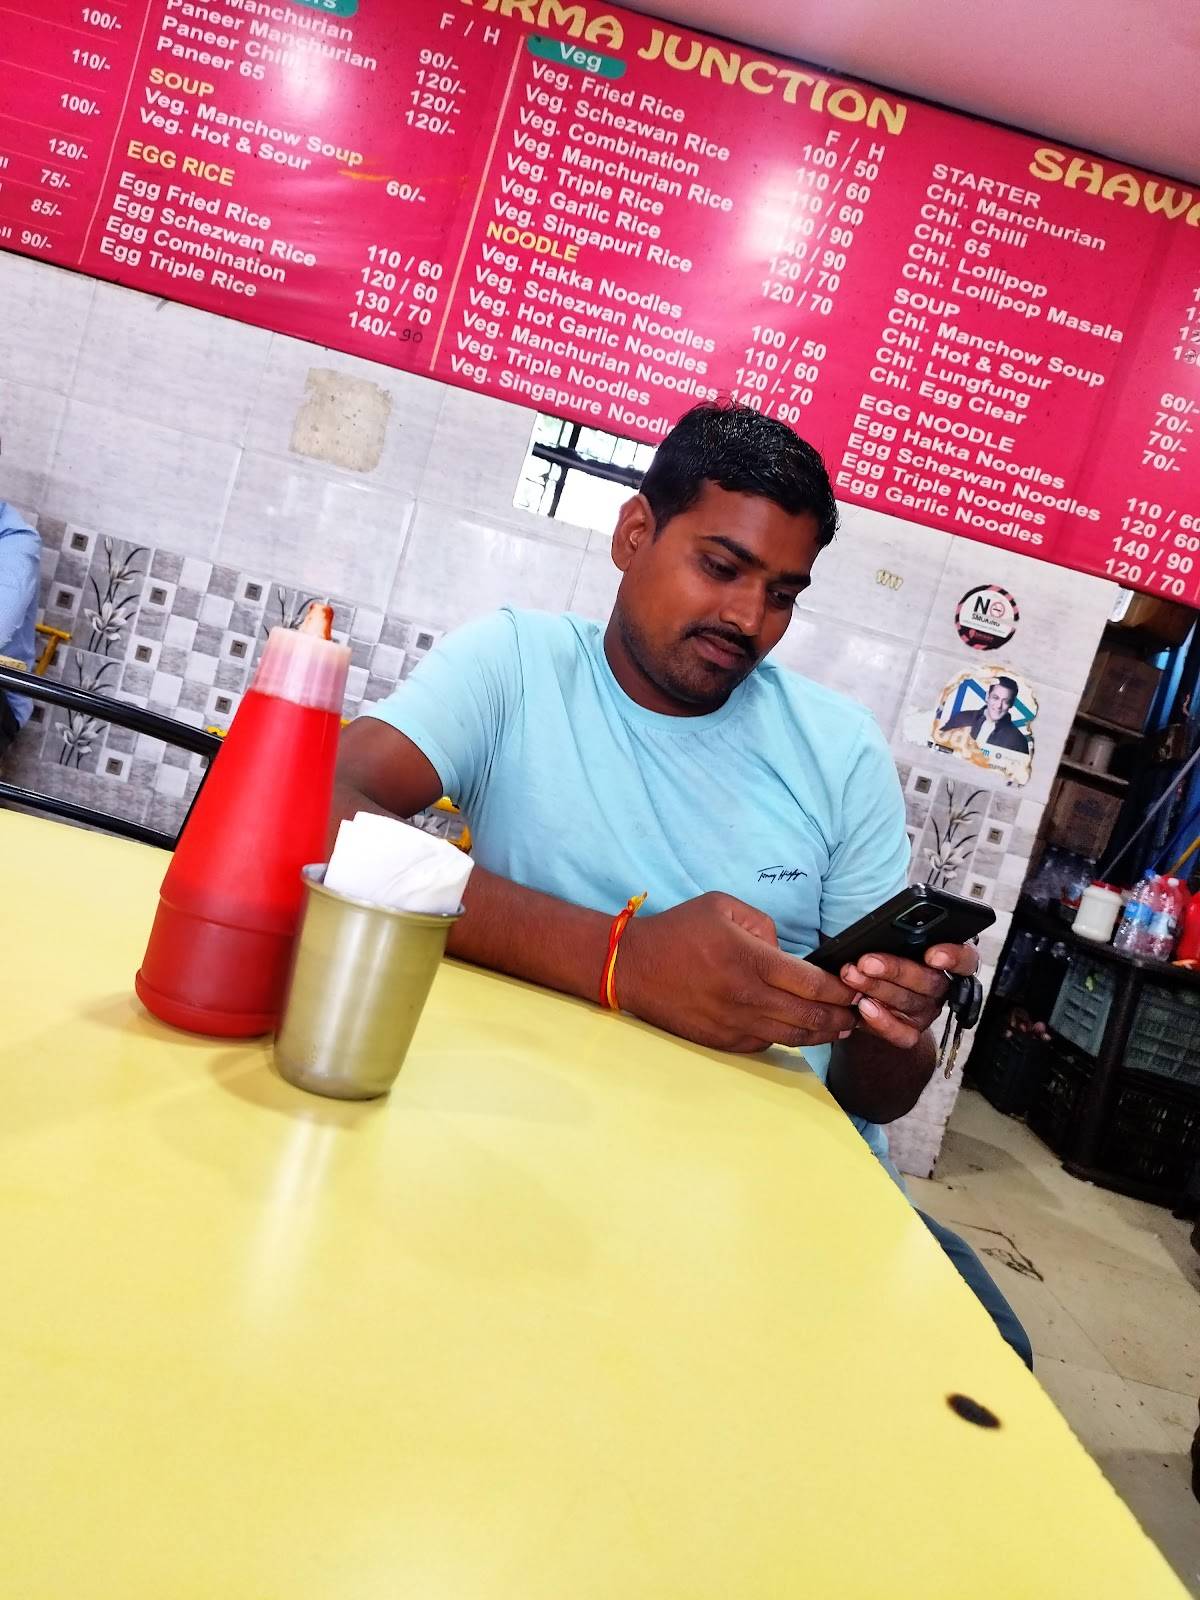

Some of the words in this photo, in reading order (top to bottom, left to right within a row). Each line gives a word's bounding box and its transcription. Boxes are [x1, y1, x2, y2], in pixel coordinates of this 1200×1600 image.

[82, 8, 122, 30] 100/-
[162, 15, 240, 51] Paneer
[72, 49, 110, 71] 110/-
[157, 35, 235, 71] Paneer
[240, 61, 271, 81] 65
[419, 49, 459, 70] 90/-
[560, 42, 602, 73] Veg
[149, 68, 214, 97] SOUP
[416, 69, 466, 94] 120/-
[532, 60, 573, 91] Veg.
[581, 76, 635, 108] Fried
[639, 94, 685, 123] Rice
[637, 29, 907, 135] JUNCTION
[61, 93, 100, 115] 100/-
[410, 90, 460, 114] 120/-
[140, 107, 183, 135] Veg.
[191, 123, 231, 148] Hot
[258, 143, 311, 170] Sour
[145, 87, 189, 116] Veg.
[197, 103, 304, 147] Manchow
[305, 132, 363, 167] Soup
[405, 110, 455, 135] 120/-
[520, 106, 560, 137] Veg.
[568, 123, 700, 177] Combination
[526, 83, 567, 114] Veg.
[574, 100, 678, 146] Schezwan
[684, 133, 730, 162] Rice
[49, 138, 88, 160] 120/-
[127, 140, 176, 169] EGG
[182, 156, 235, 187] RICE
[803, 144, 837, 169] 100
[854, 160, 879, 181] 50
[41, 169, 71, 188] 75/-
[507, 152, 548, 183] Veg.
[558, 167, 613, 200] Triple
[618, 187, 664, 216] Rice
[514, 129, 554, 160] Veg.
[561, 145, 682, 197] Manchurian
[687, 183, 736, 214] Rice
[932, 164, 1041, 209] STARTER
[31, 199, 62, 216] 85/-
[119, 171, 161, 201] Egg
[166, 185, 221, 215] Fried
[225, 202, 271, 230] Rice
[386, 180, 425, 202] 60/-
[501, 175, 542, 206] Veg.
[549, 191, 610, 224] Garlic
[615, 211, 661, 239] Rice
[846, 182, 870, 203] 60
[113, 193, 155, 223] Egg
[160, 208, 265, 252] Schezwan
[270, 239, 316, 266] Rice
[838, 205, 864, 226] 60
[920, 204, 962, 229] Chi.
[970, 219, 1028, 248] Chilli
[926, 184, 968, 209] Chi.
[976, 198, 1106, 251] Manchurian
[21, 230, 52, 249] 90/-
[106, 215, 148, 244] Egg
[154, 229, 286, 282] Combination
[486, 221, 580, 263] NOODLE
[495, 198, 535, 228] Veg.
[542, 214, 643, 258] Singapuri
[647, 245, 693, 273] Rice
[829, 226, 853, 248] 90
[914, 223, 956, 248] Chi.
[964, 238, 991, 258] 65
[100, 236, 142, 266] Egg
[149, 250, 205, 281] Triple
[211, 269, 257, 297] Rice
[368, 245, 401, 268] 110
[418, 260, 443, 280] 60
[822, 250, 846, 271] 90
[908, 243, 950, 268] Chi.
[958, 257, 1048, 299] Lollipop
[361, 267, 396, 291] 120
[413, 282, 438, 304] 60
[482, 243, 523, 272] Veg.
[530, 258, 593, 292] Hakka
[598, 278, 683, 319] Noodles
[817, 270, 840, 292] 70
[355, 289, 390, 313] 130
[408, 304, 432, 325] 70
[476, 264, 516, 295] Veg.
[524, 280, 627, 326] Schezwan
[632, 313, 715, 353] Noodles
[810, 294, 833, 315] 70
[894, 288, 960, 317] SOUP
[902, 263, 944, 288] Chi.
[951, 277, 1041, 318] Lollipop
[1047, 306, 1123, 343] Masala
[349, 311, 397, 337] 140/-
[463, 309, 504, 340] Veg.
[511, 325, 630, 376] Manchurian
[469, 287, 510, 317] Veg.
[517, 303, 555, 328] Hot
[559, 316, 619, 348] Garlic
[624, 335, 708, 375] Noodles
[751, 325, 786, 349] 100
[802, 340, 826, 361] 50
[745, 347, 778, 371] 110
[794, 362, 819, 383] 60
[882, 327, 923, 352] Chi.
[931, 342, 971, 366] Hot
[998, 363, 1052, 390] Sour
[888, 308, 929, 333] Chi.
[937, 322, 1043, 366] Manchow
[1047, 357, 1105, 387] Soup
[451, 354, 491, 384] Veg.
[499, 370, 602, 415] Singapure
[457, 331, 497, 362] Veg.
[507, 346, 562, 378] Triple
[567, 366, 650, 406] Noodles
[736, 367, 768, 391] 120
[789, 384, 813, 405] 70
[876, 347, 917, 372] Chi.
[925, 361, 1030, 409] Lungfung
[777, 403, 800, 424] 90
[870, 367, 911, 391] Chi.
[918, 380, 963, 409] Egg
[968, 396, 1027, 425] Clear
[859, 394, 911, 421] EGG
[916, 411, 1015, 453] NOODLE
[1148, 430, 1187, 452] 70/-
[1155, 412, 1193, 433] 70/-
[853, 413, 897, 442] Egg
[903, 428, 970, 461] Hakka
[976, 450, 1065, 489] Noodles
[1142, 450, 1180, 471] 70/-
[841, 452, 885, 480] Egg
[893, 466, 951, 496] Triple
[957, 486, 1046, 525] Noodles
[848, 432, 891, 461] Egg
[897, 448, 1006, 493] Schezwan
[1012, 482, 1101, 521] Noodles
[835, 471, 879, 499] Egg
[885, 486, 949, 517] Garlic
[955, 506, 1043, 545] Noodles
[1121, 516, 1157, 538] 120
[1127, 497, 1162, 519] 110
[1113, 536, 1150, 560] 140
[1166, 553, 1193, 574] 90
[1105, 558, 1142, 582] 120
[1160, 574, 1186, 596] 70
